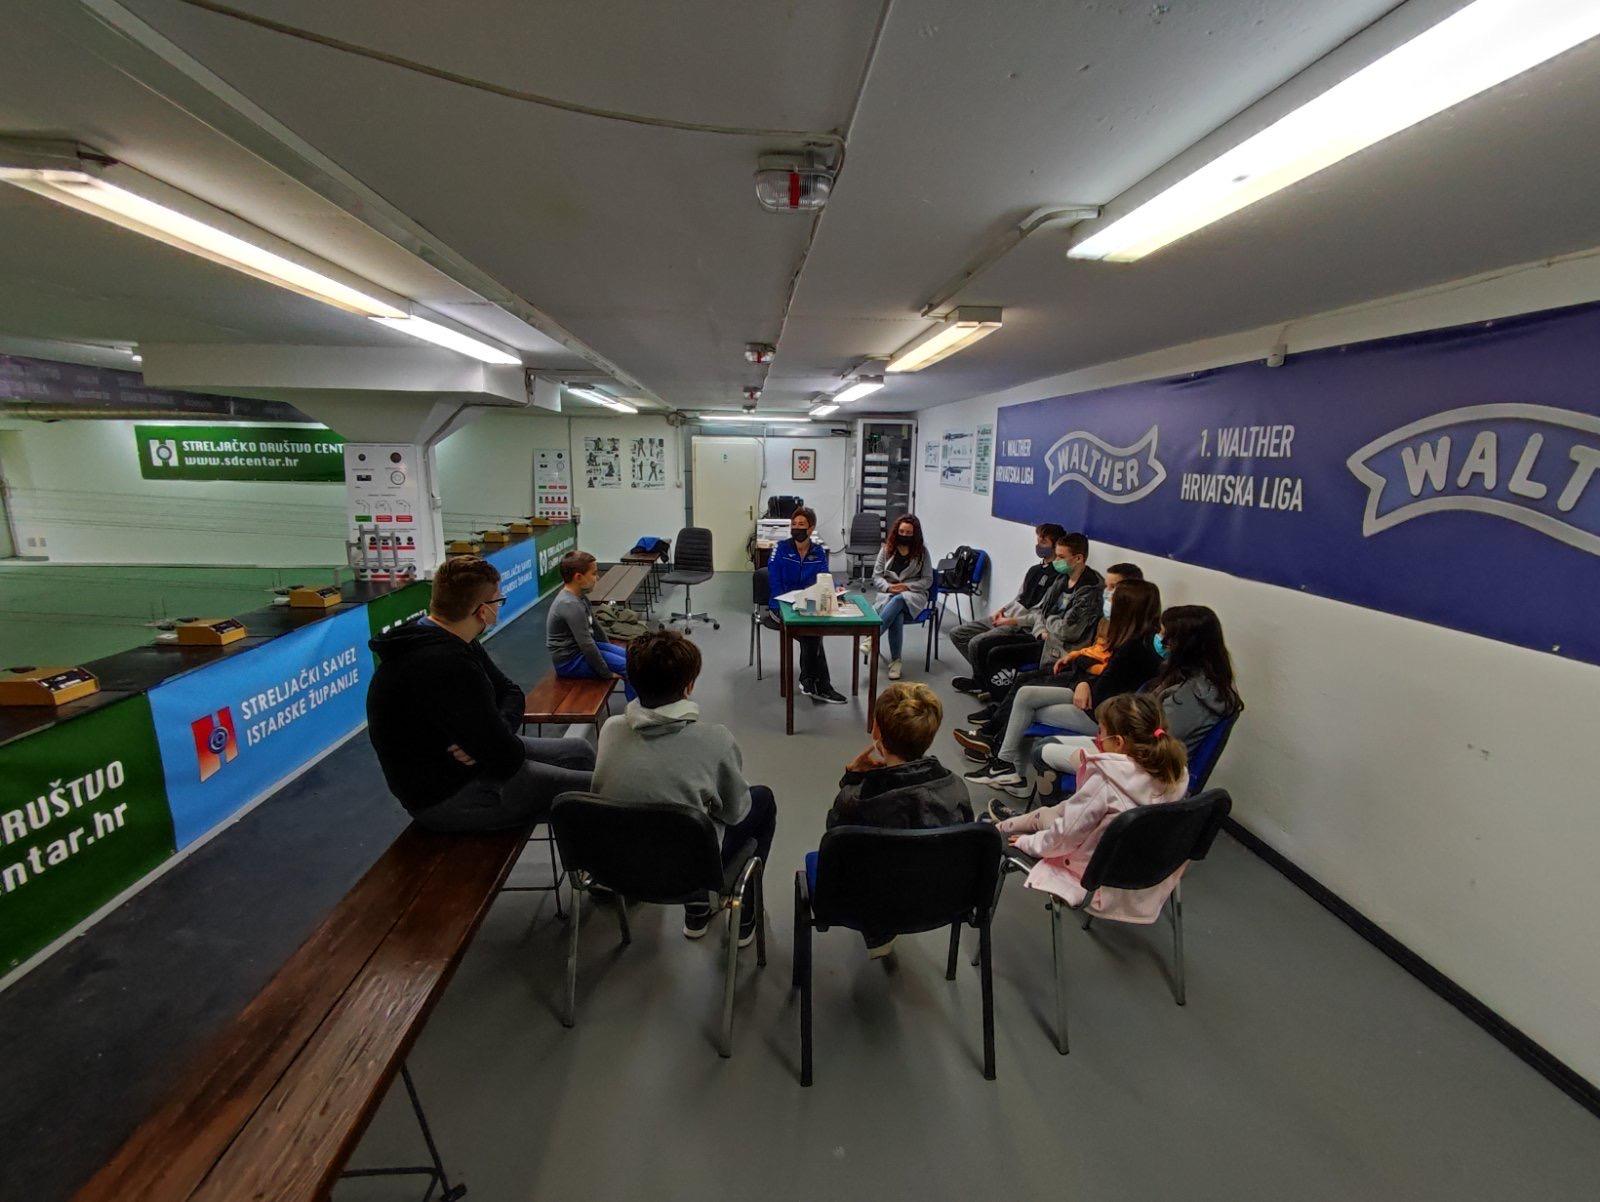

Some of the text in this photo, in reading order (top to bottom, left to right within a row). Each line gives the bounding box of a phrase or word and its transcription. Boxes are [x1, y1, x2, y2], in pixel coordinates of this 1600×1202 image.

[184, 455, 299, 467] www.sdcentar.hr
[1201, 424, 1295, 457] 1. WALTHER
[1057, 443, 1139, 491] WALTHER
[1180, 473, 1303, 512] HRVATSKA LIGA
[241, 647, 357, 721] STRELJAČKI SAVEZ
[246, 668, 360, 747] ISTARSKE ŽUPANIJE
